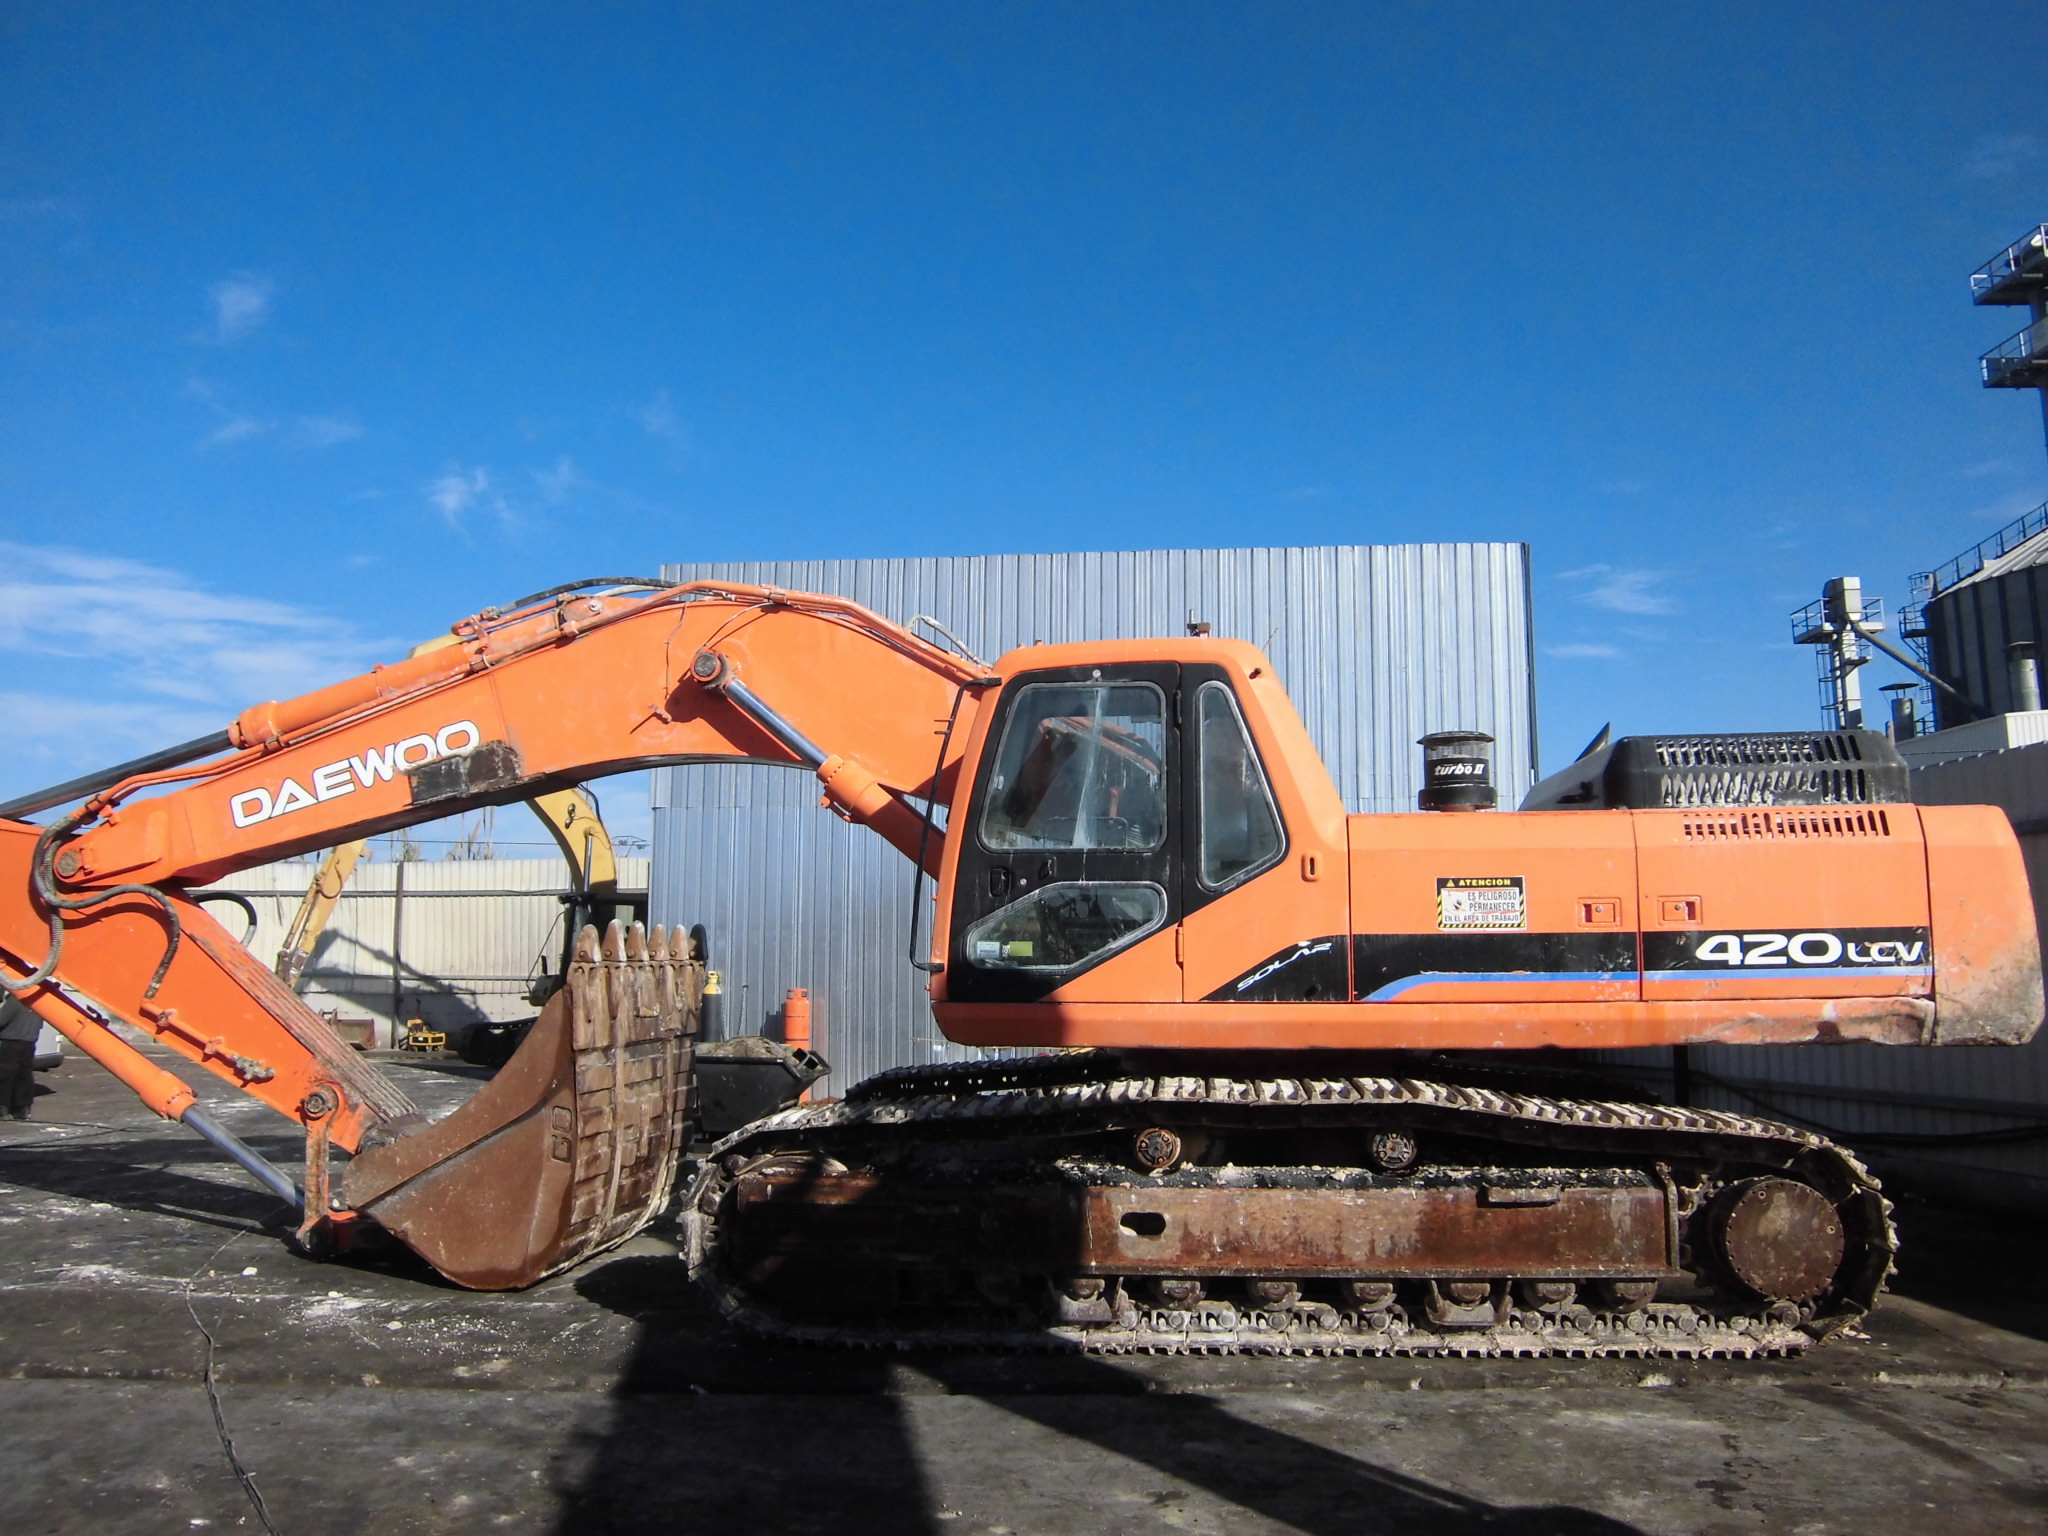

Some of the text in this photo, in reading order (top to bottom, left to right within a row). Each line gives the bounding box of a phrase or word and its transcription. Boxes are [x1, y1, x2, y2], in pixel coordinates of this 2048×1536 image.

[229, 719, 481, 829] DAEWOO
[1458, 878, 1511, 887] ATENCION
[1467, 891, 1517, 901] ES PELIGROSO
[1469, 902, 1516, 912] PERMANECER
[1694, 932, 1924, 966] 420 LCV
[1237, 942, 1333, 992] SOLAR
